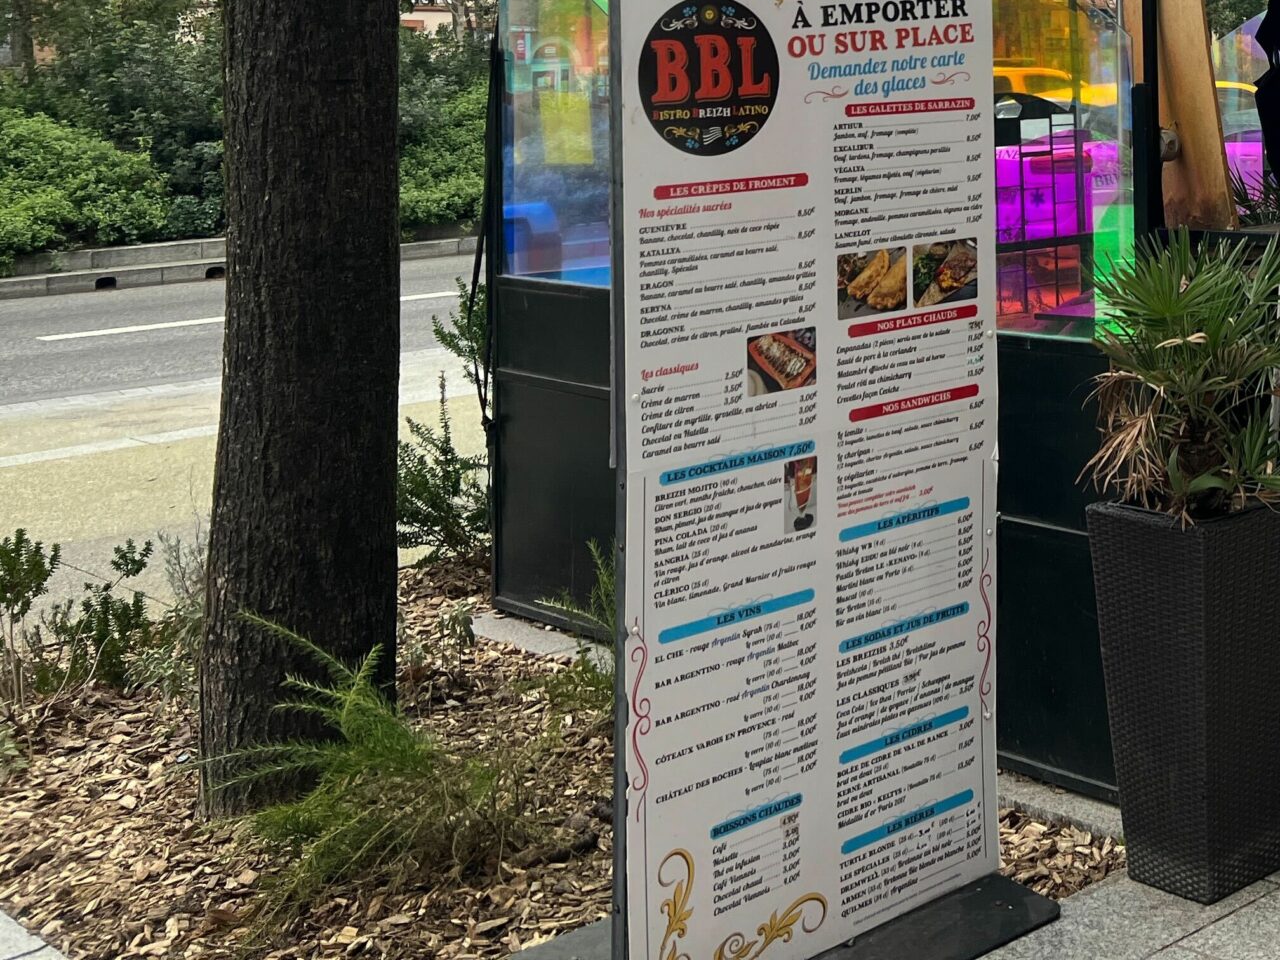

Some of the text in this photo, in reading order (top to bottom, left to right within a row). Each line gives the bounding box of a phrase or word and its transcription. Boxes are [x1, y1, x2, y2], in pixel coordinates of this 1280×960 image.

[792, 1, 812, 28] À
[787, 23, 974, 58] OU SUR PLACE
[651, 35, 771, 103] BBL
[808, 51, 966, 80] Demandez notre carte
[854, 76, 926, 98] des glaces
[653, 105, 768, 120] BISTRO BREIZH LATINO
[851, 106, 867, 114] LES
[869, 104, 913, 113] GALETTES
[928, 100, 970, 110] SARRAZIN
[834, 144, 874, 152] EXCALIBUR
[670, 177, 796, 197] LES CRÊPES DE FROMENT
[834, 187, 862, 195] MERLIN
[639, 202, 732, 219] Nos spécialités sucrées
[835, 208, 869, 217] MORGANE
[835, 230, 871, 239] LANCELOT
[640, 247, 681, 258] KATALLYA
[640, 280, 673, 291] ERAGON
[640, 304, 671, 315] SERYNA
[877, 310, 957, 331] NOS PLATS CHAUDS
[641, 325, 685, 338] DRAGONNE
[641, 362, 699, 380] Les classiques
[641, 398, 662, 409] Crème
[664, 396, 672, 404] de
[674, 392, 700, 402] marron
[882, 392, 951, 414] NOS SANDWICHS
[642, 411, 662, 422] Crème
[664, 409, 672, 417] de
[674, 406, 694, 414] citron
[642, 422, 673, 434] Confiture
[674, 420, 682, 428] de
[684, 414, 713, 428] myrtille,
[714, 408, 744, 422] groseille,
[755, 401, 778, 411] abricot
[642, 434, 672, 446] Chocolat
[684, 427, 709, 438] Nutella
[642, 435, 721, 458] Caramel au beurre salé
[667, 470, 686, 482] LES
[688, 457, 745, 476] COCKTAILS
[747, 448, 786, 463] MAISON
[655, 482, 718, 502] BREIZH MOJITO
[655, 507, 702, 524] DON SERGIO
[878, 507, 939, 530] LES APÉRITIFS
[654, 554, 689, 568] SANGRIA
[654, 584, 690, 600] CLÉRICO
[716, 605, 761, 625] LES VINS
[846, 604, 964, 650] LES SODAS ET JUS DE FRUITS
[655, 642, 710, 664] EL CHE rouge
[837, 646, 886, 668] LES BREIZHS
[655, 656, 745, 690] BAR ARGENTINO rouge
[837, 679, 899, 707] LES CLASSIQUES
[655, 701, 721, 727] BAR ARGENTINO
[655, 718, 777, 765] CÔTEAUX VAROIS EN PROVENCE
[885, 721, 933, 745] LES CIDRES
[656, 767, 743, 804] CHÂTEAU DES ROCHES
[863, 769, 900, 789] ARTISANAL
[713, 795, 801, 837] BOISSONS CHAUDES
[887, 808, 935, 834] LES BIÈRES
[712, 842, 727, 855] Café
[840, 841, 895, 870] TURTLE BLONDE
[841, 898, 873, 918] QUILMES
